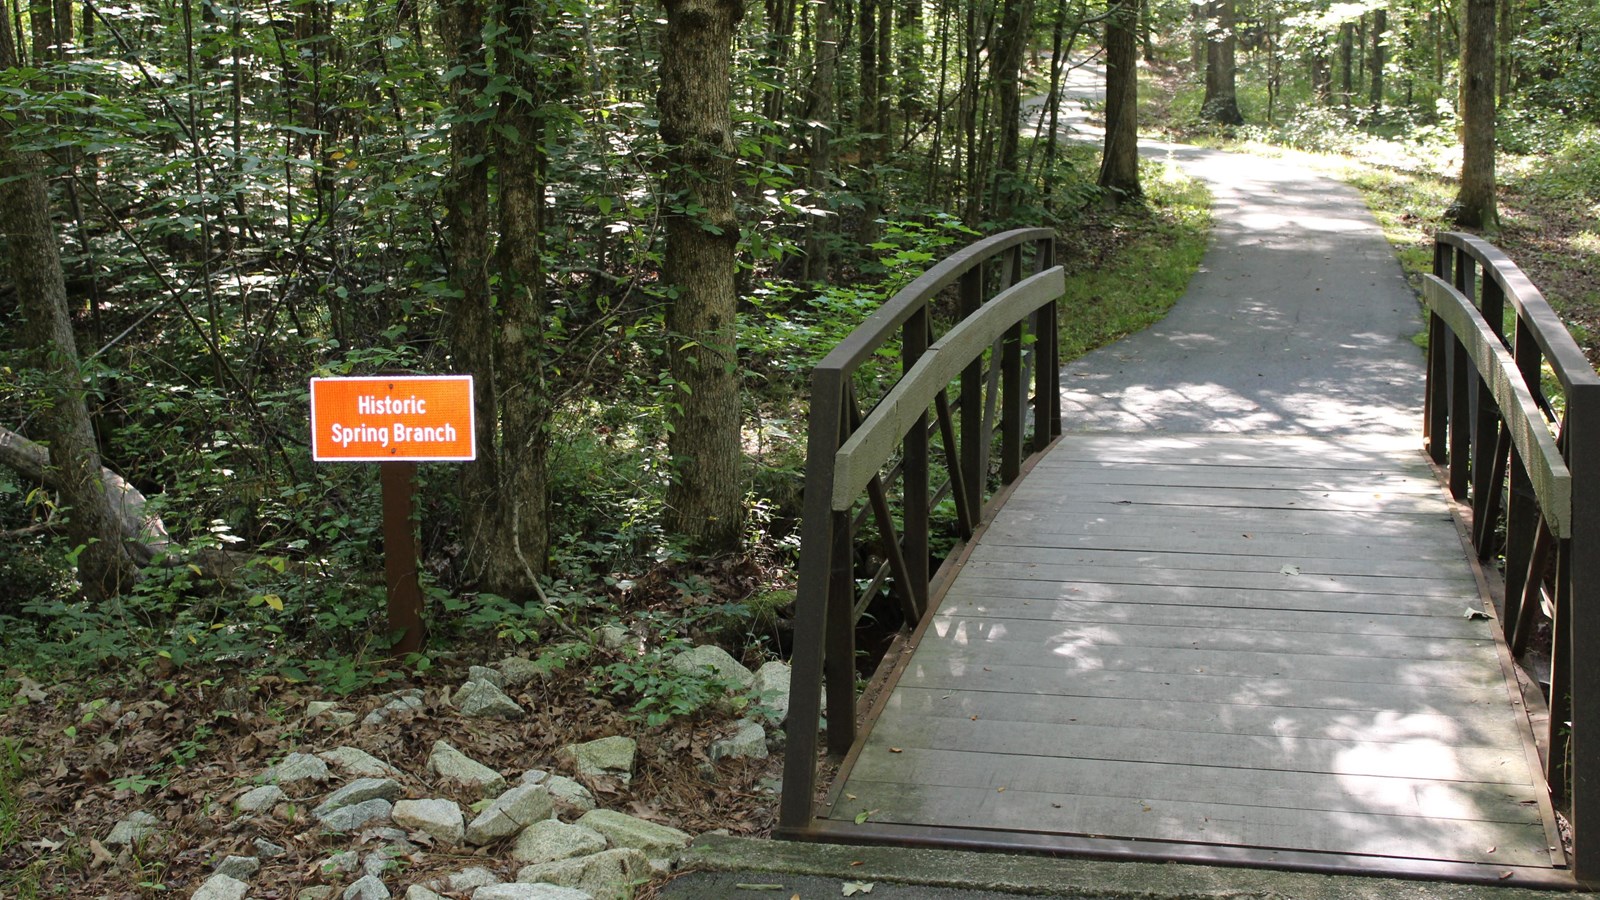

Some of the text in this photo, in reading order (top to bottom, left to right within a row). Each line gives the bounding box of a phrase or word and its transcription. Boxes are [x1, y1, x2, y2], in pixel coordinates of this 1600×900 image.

[358, 395, 426, 415] Historic
[331, 423, 456, 448] Spring Branch
